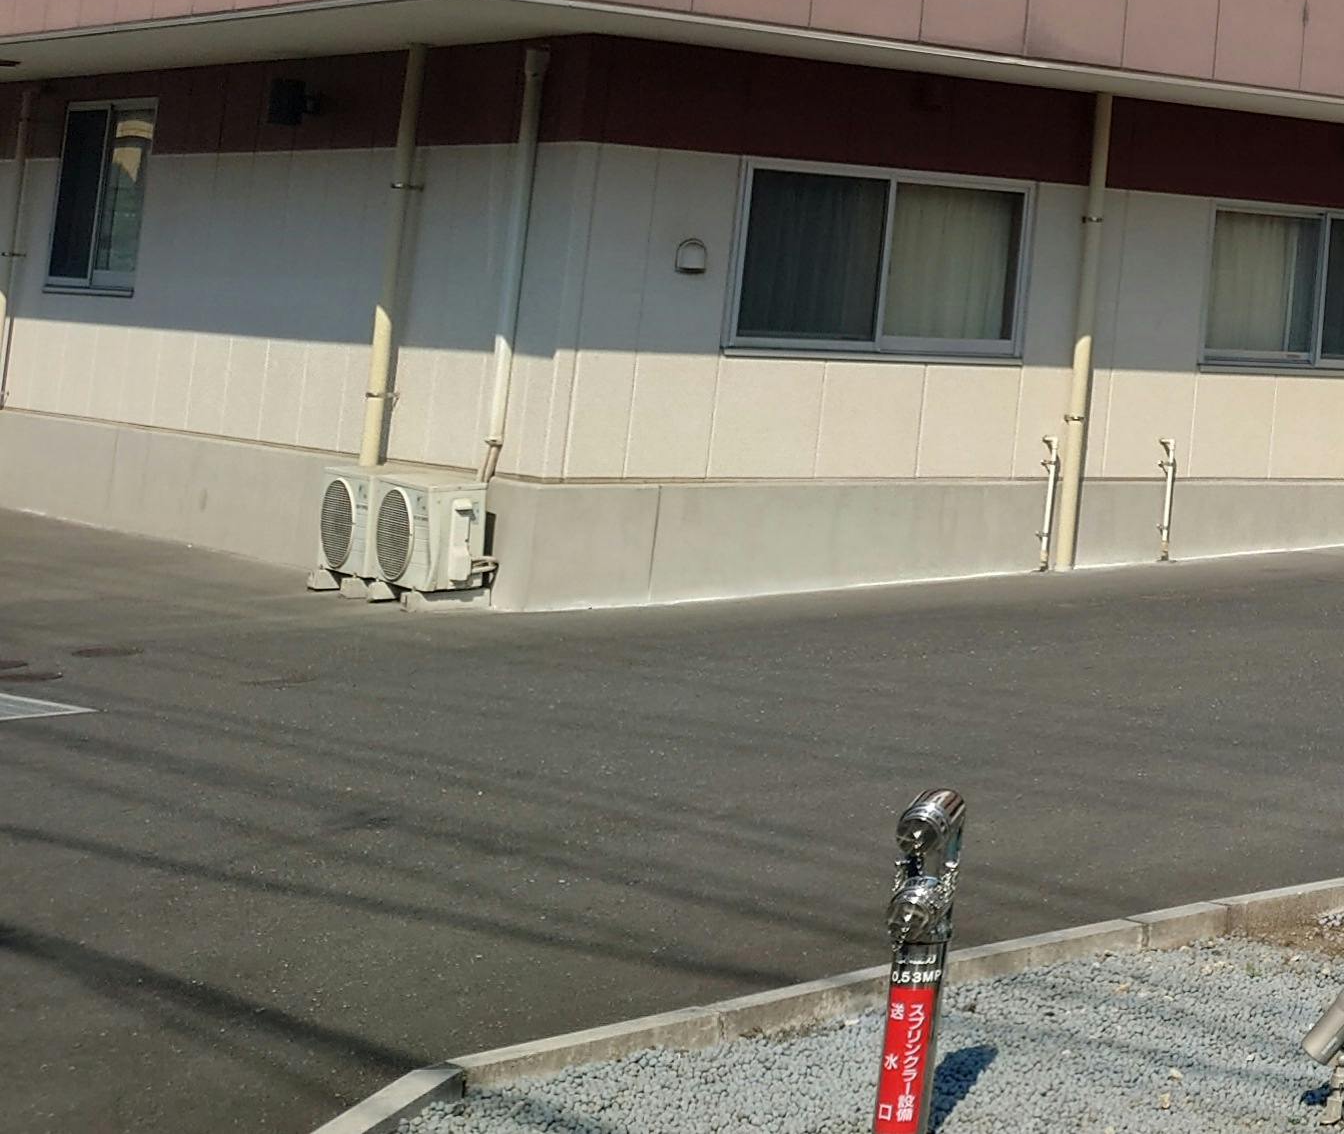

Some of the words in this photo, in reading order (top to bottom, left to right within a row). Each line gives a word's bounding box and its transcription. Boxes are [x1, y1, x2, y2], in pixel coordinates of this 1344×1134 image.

[878, 1002, 905, 1122] 送水口
[895, 1003, 925, 1123] スプリンクラー設備
